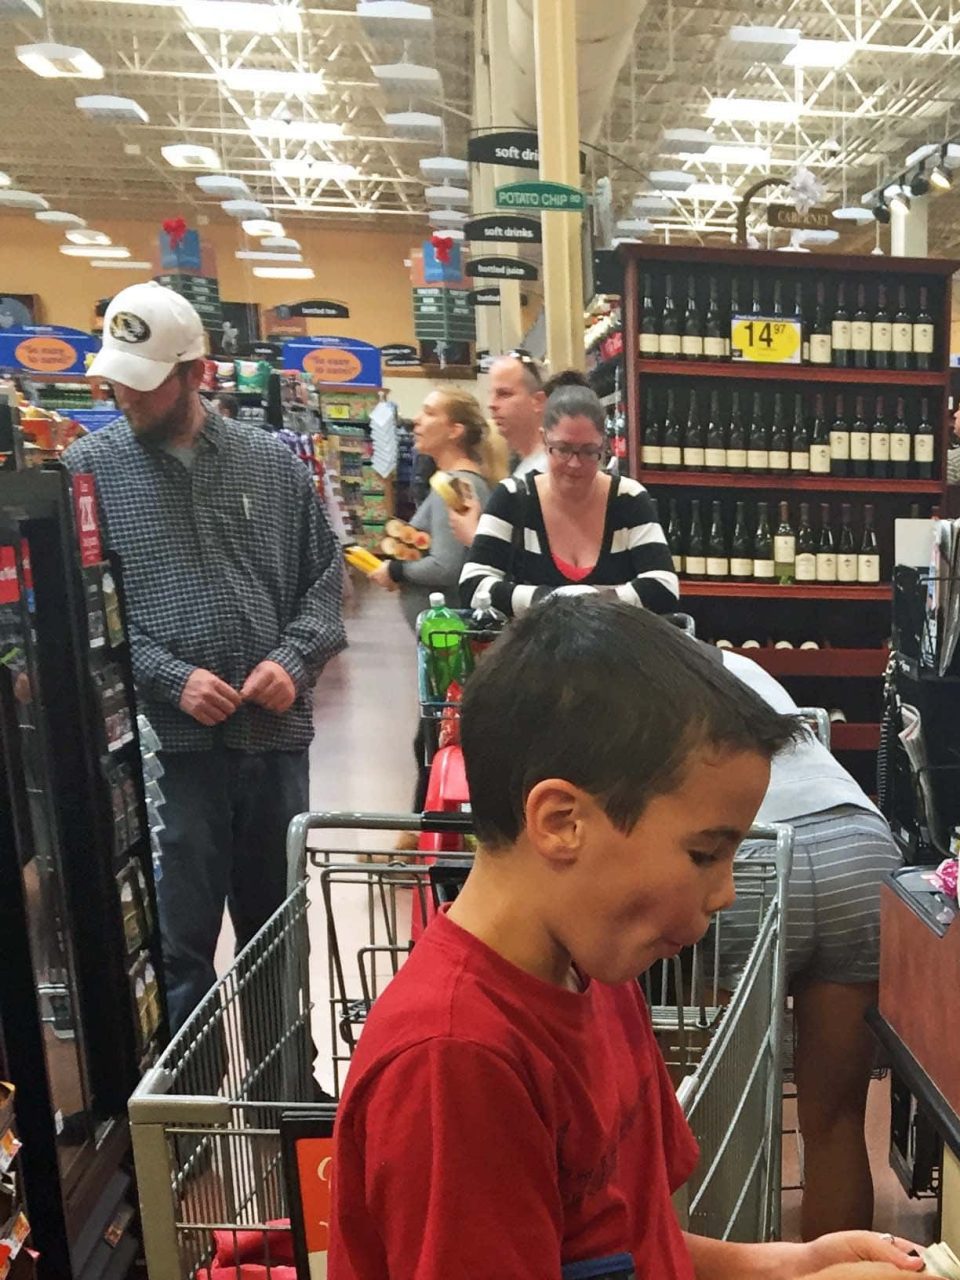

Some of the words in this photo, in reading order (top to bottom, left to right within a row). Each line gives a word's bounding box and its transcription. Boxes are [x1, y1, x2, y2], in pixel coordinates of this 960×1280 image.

[495, 146, 519, 159] soft
[499, 192, 539, 205] POTATO
[541, 194, 567, 206] CHIP
[484, 226, 503, 236] soft
[504, 227, 534, 238] drinks
[744, 321, 773, 347] 14
[773, 323, 786, 335] 97
